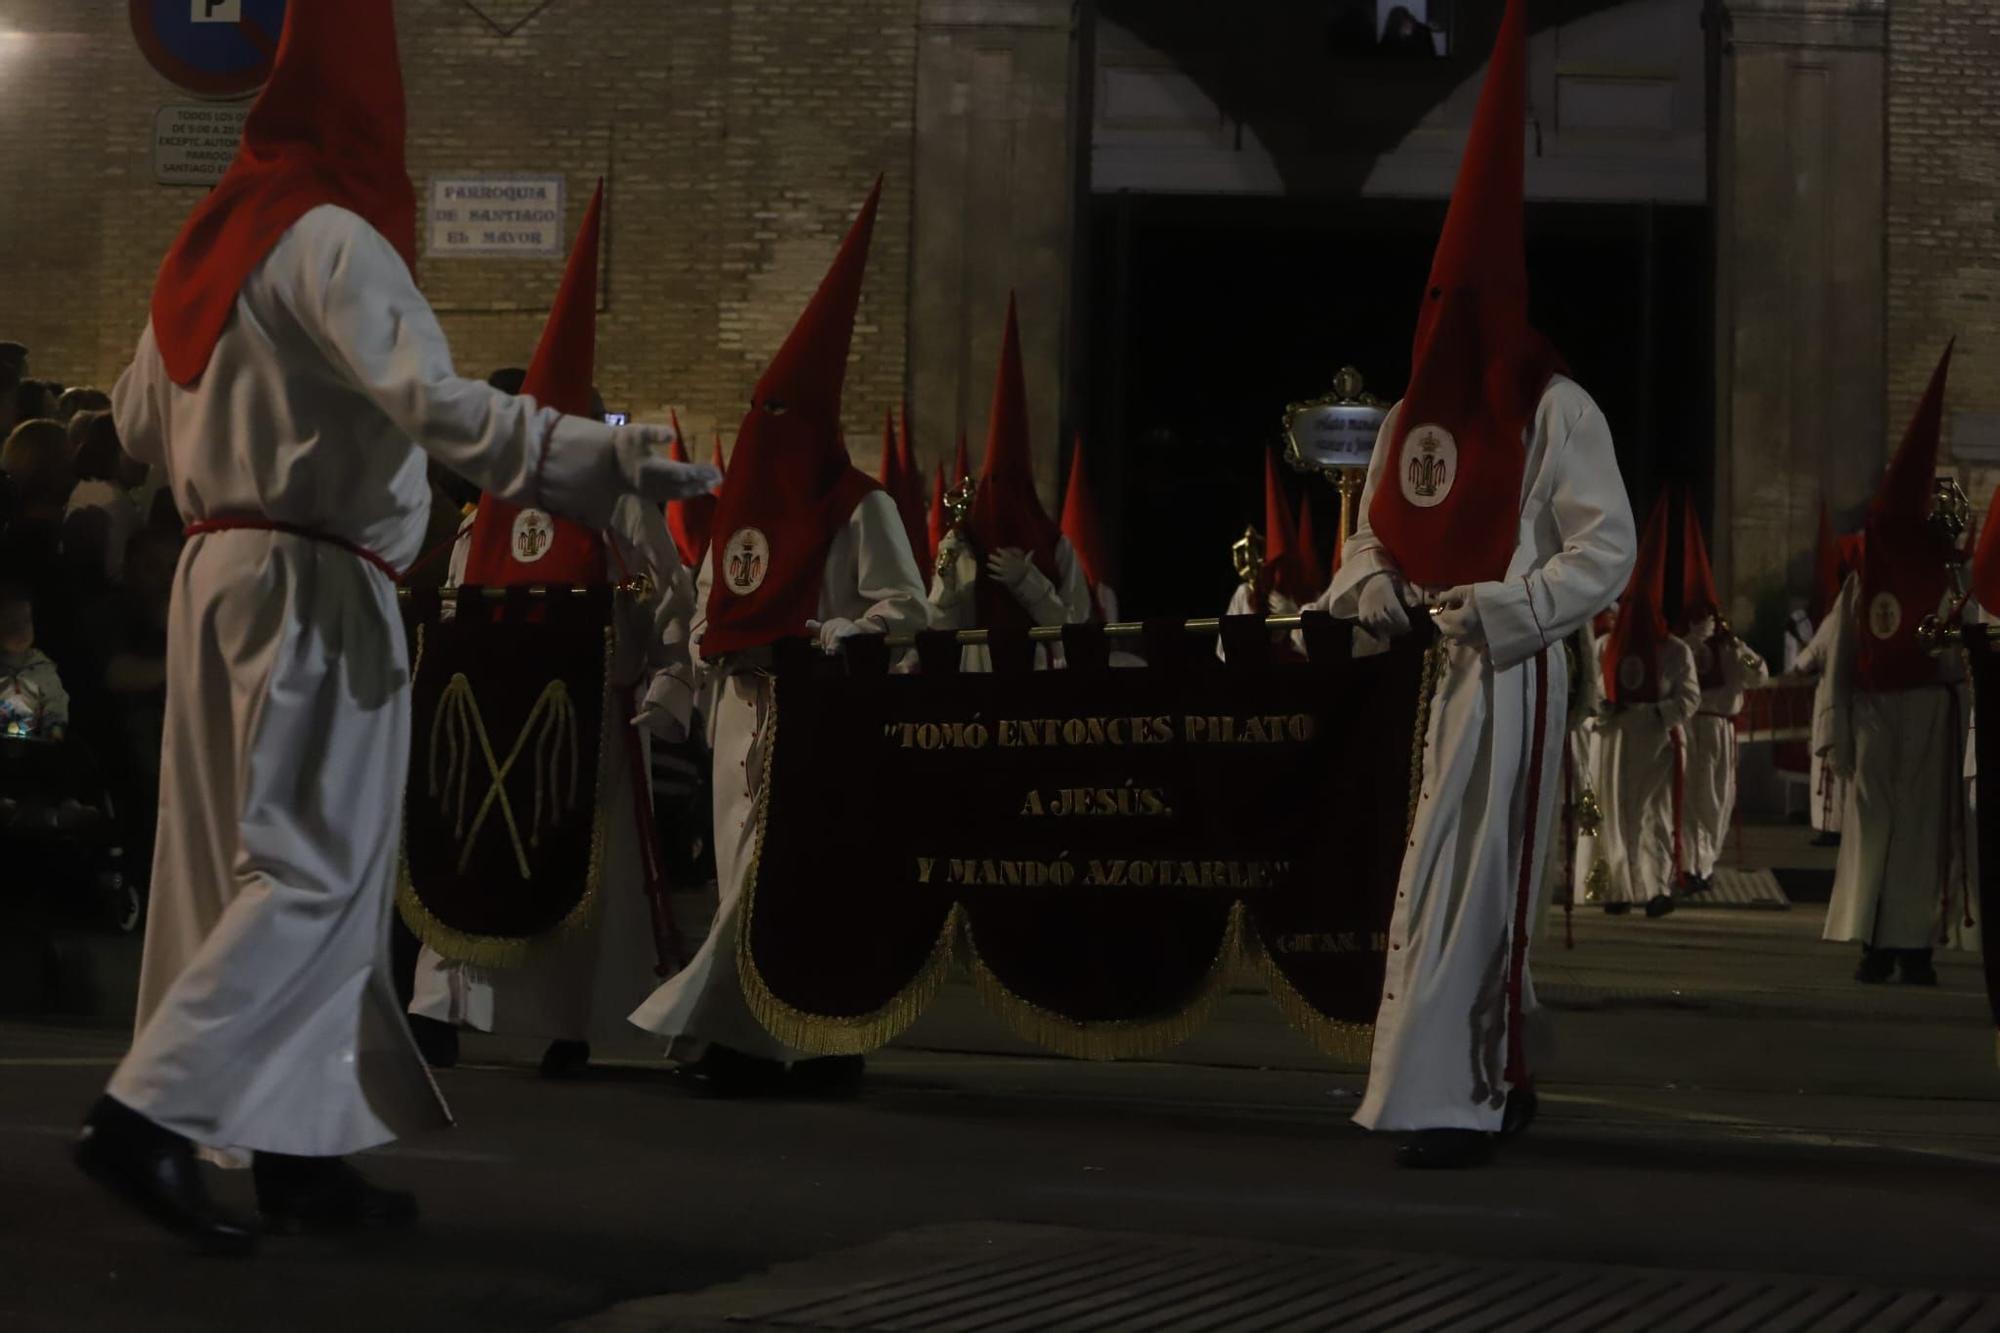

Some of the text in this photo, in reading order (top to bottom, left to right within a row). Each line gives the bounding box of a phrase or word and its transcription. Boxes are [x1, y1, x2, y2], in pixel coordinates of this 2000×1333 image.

[178, 111, 212, 121] TODOS
[163, 164, 215, 173] SANTIAGO
[444, 187, 546, 200] PARROQUIA
[435, 210, 554, 221] DE SANTIAGO
[447, 231, 541, 244] EL MAYOR
[884, 711, 1314, 750] "TOMÓ ENTONCES PILATO
[1019, 789, 1045, 816] A
[914, 849, 1296, 888] Y MANDÓ AZOTARLE"
